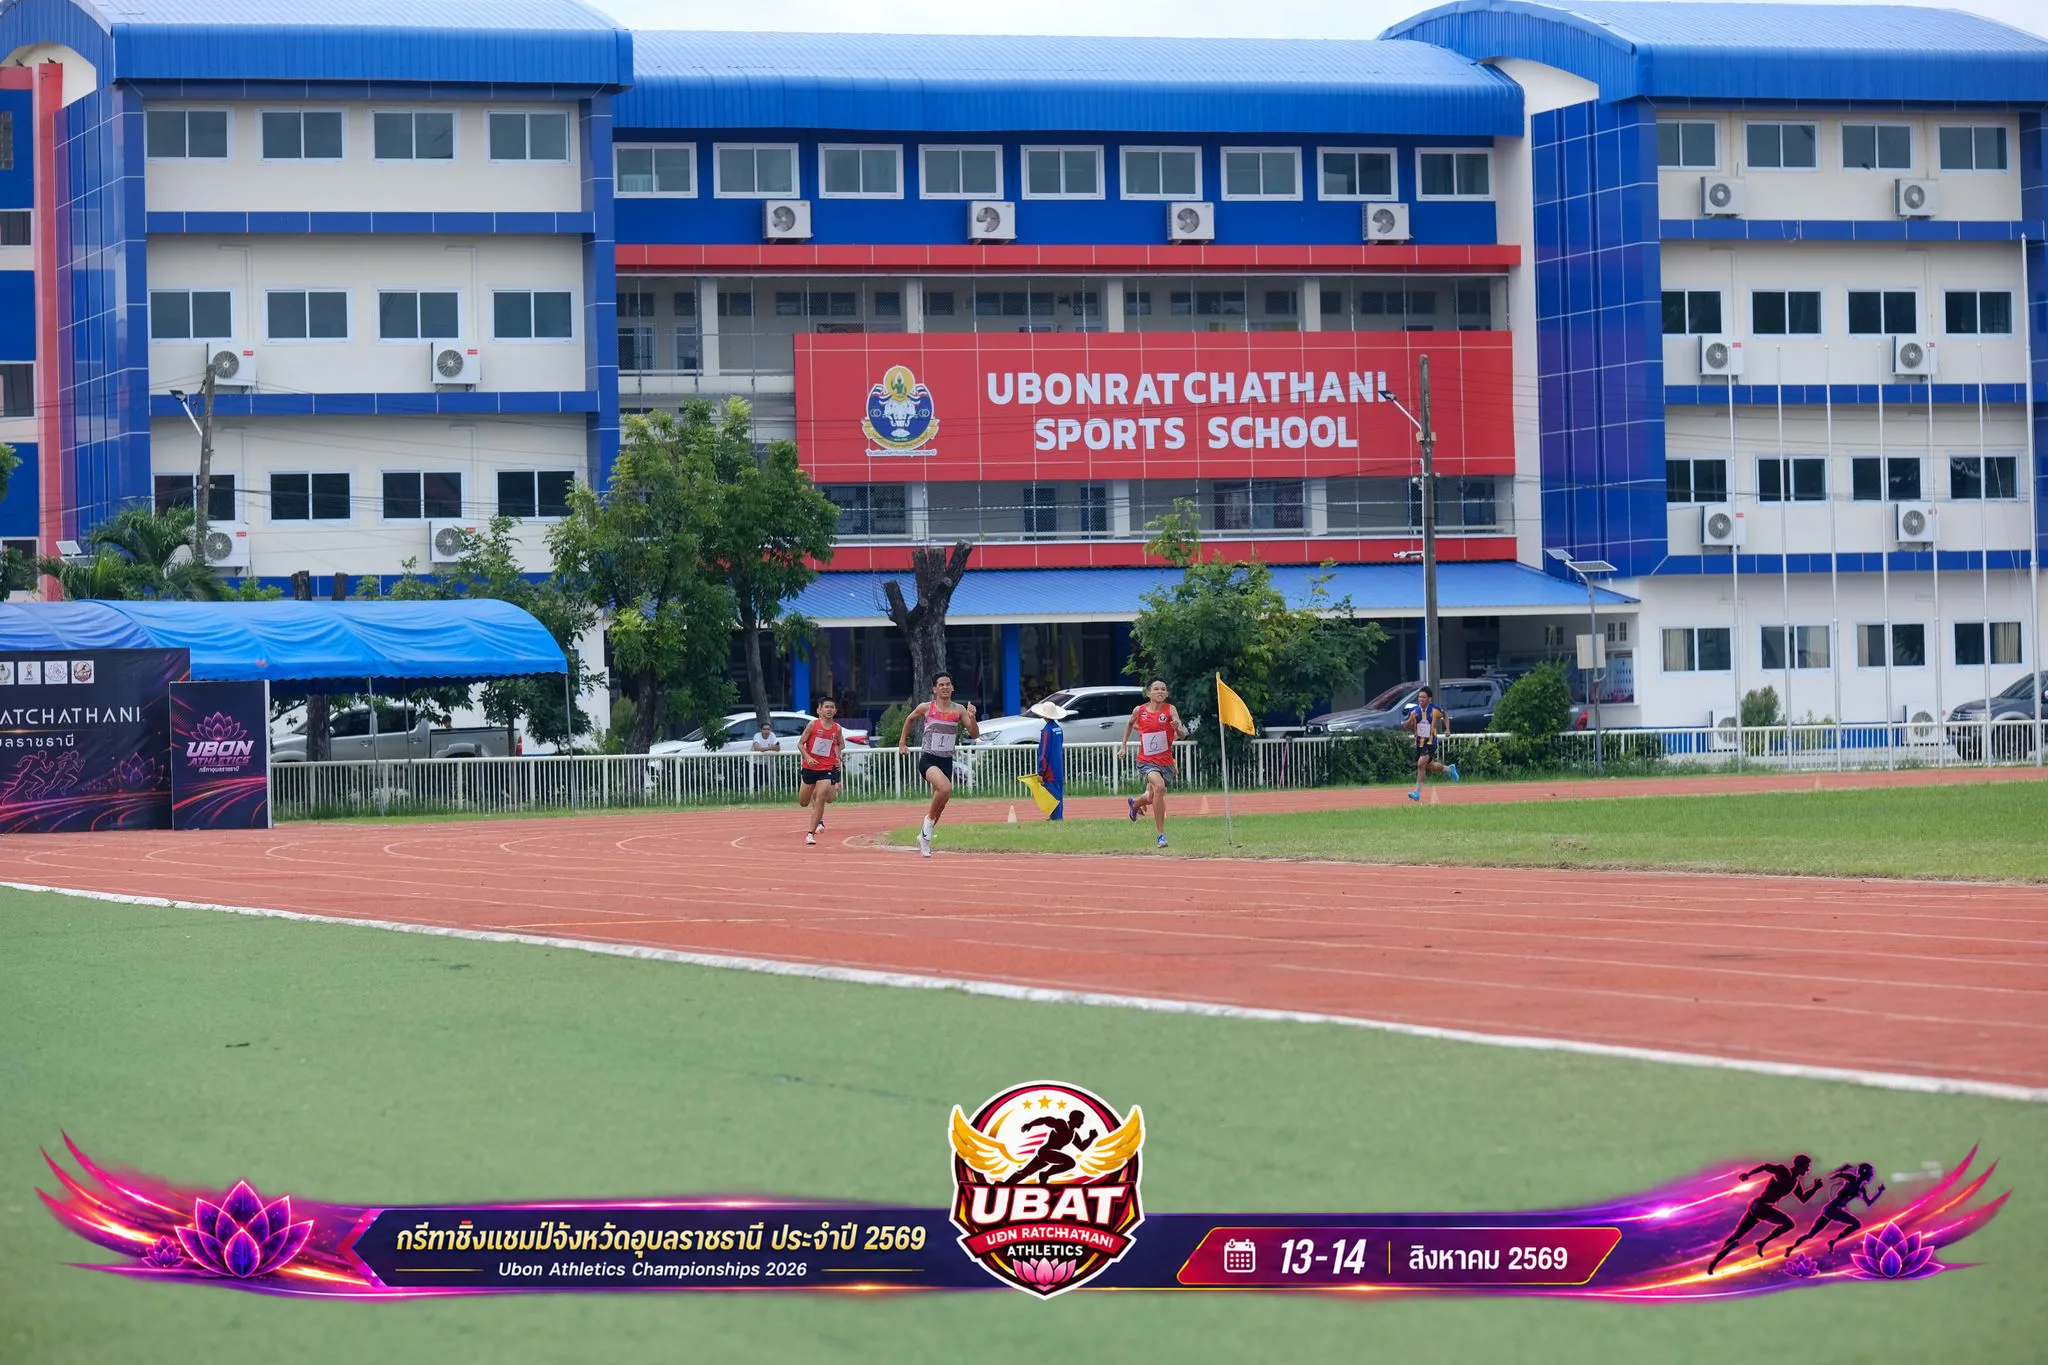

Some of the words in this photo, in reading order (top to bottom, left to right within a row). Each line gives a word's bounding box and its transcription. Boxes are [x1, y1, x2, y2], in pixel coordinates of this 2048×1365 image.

[987, 371, 1388, 406] UBONRATCHATHANI
[1034, 416, 1186, 451] SPORTS
[1207, 415, 1359, 449] SCHOOL
[0, 733, 75, 748] ลราชธานี
[817, 741, 827, 753] 2
[937, 735, 945, 748] 1
[1149, 735, 1159, 750] 6
[186, 740, 255, 758] UBON
[187, 756, 252, 766] ATHLETICS
